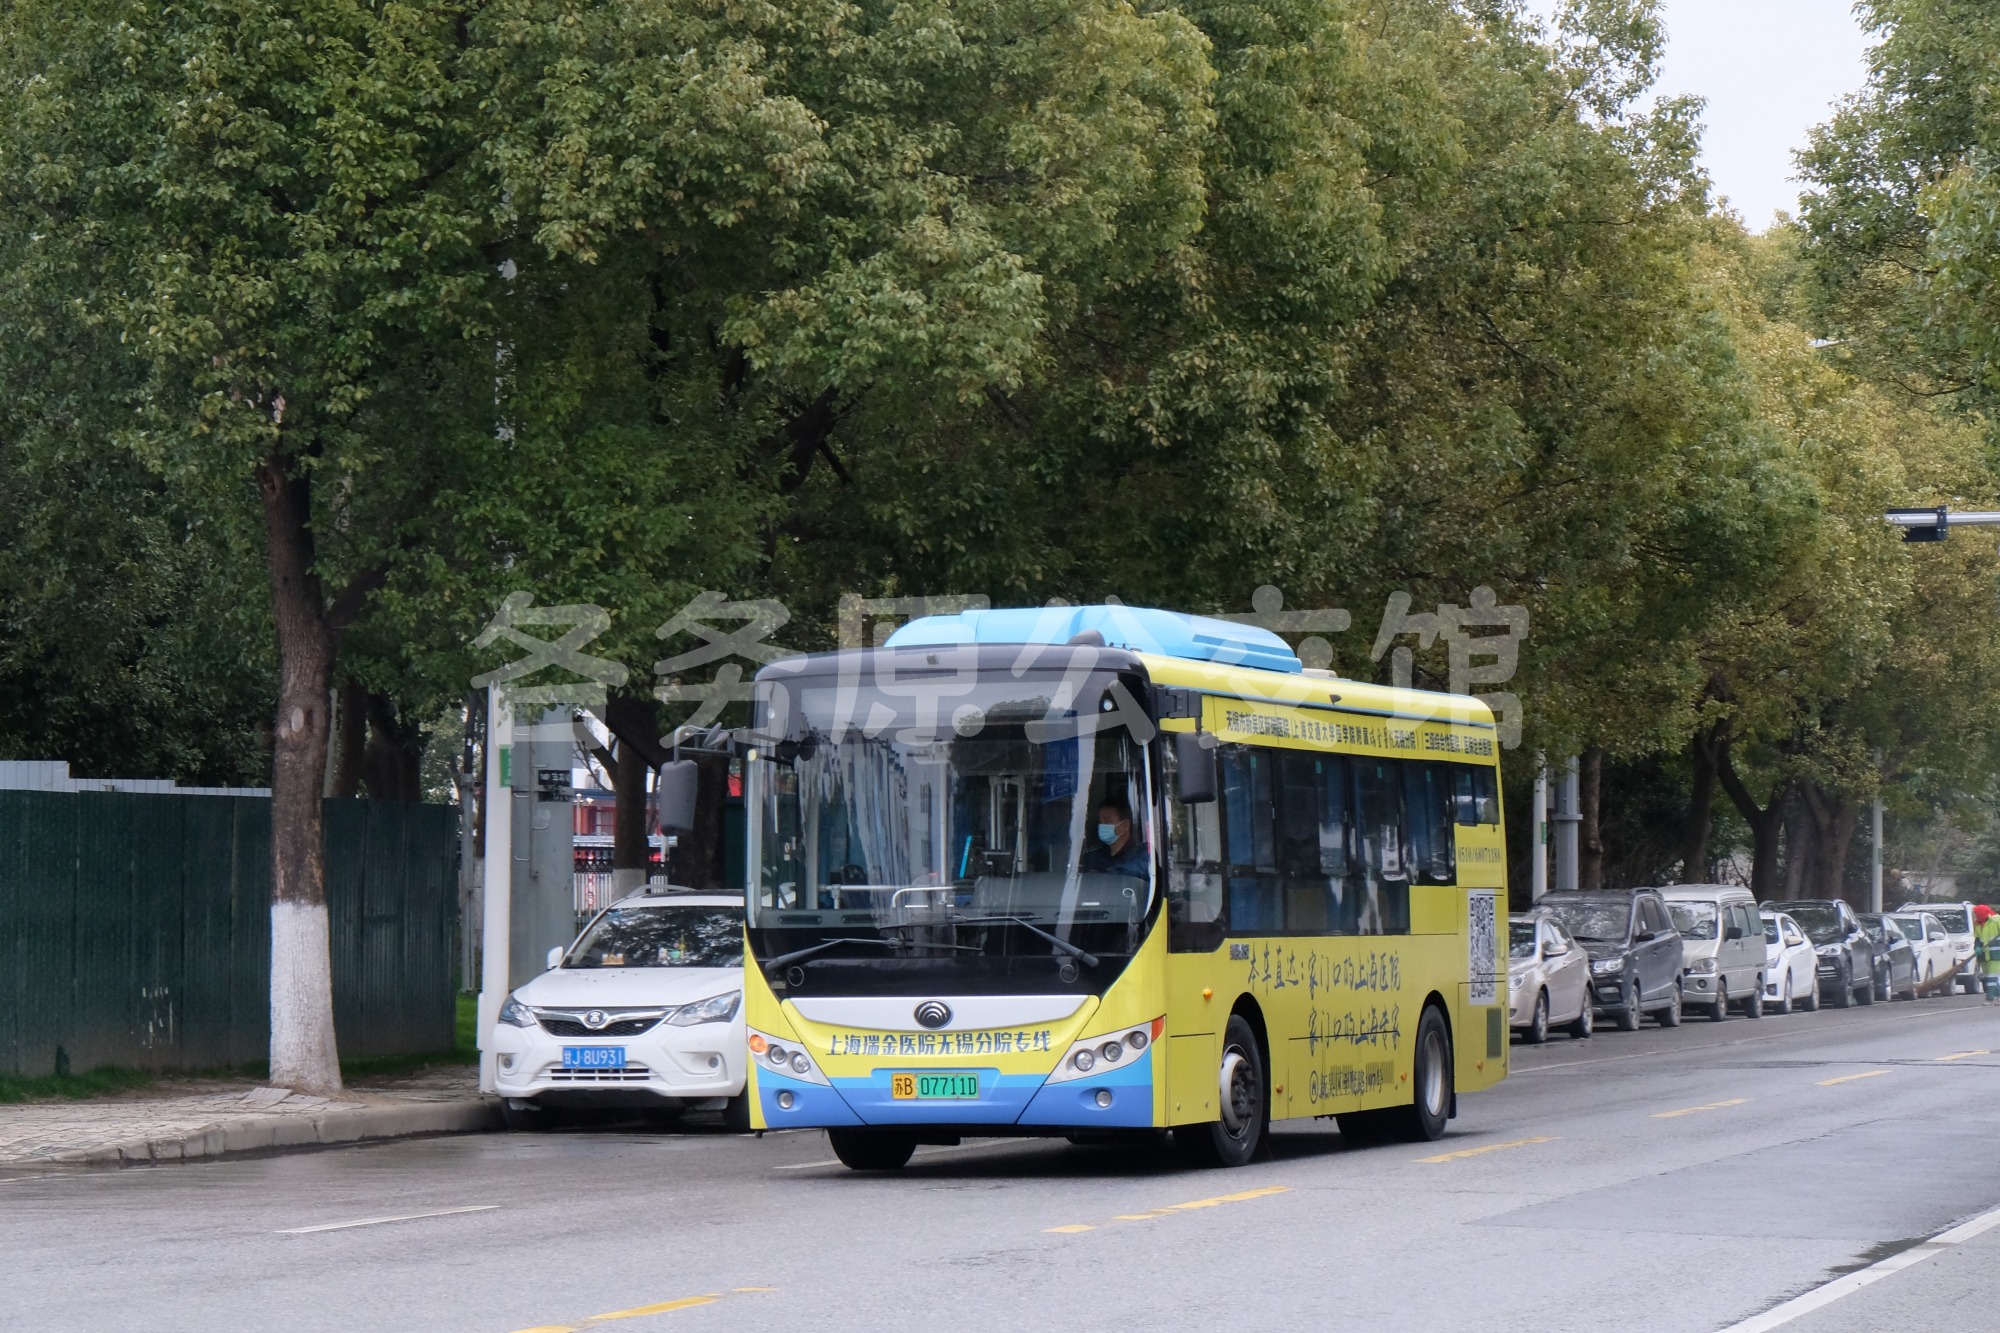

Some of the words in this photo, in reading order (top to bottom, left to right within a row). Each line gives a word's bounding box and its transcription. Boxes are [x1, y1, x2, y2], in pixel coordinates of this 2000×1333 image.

[825, 1030, 1053, 1057] 上海瑞金医院无锡分院专线
